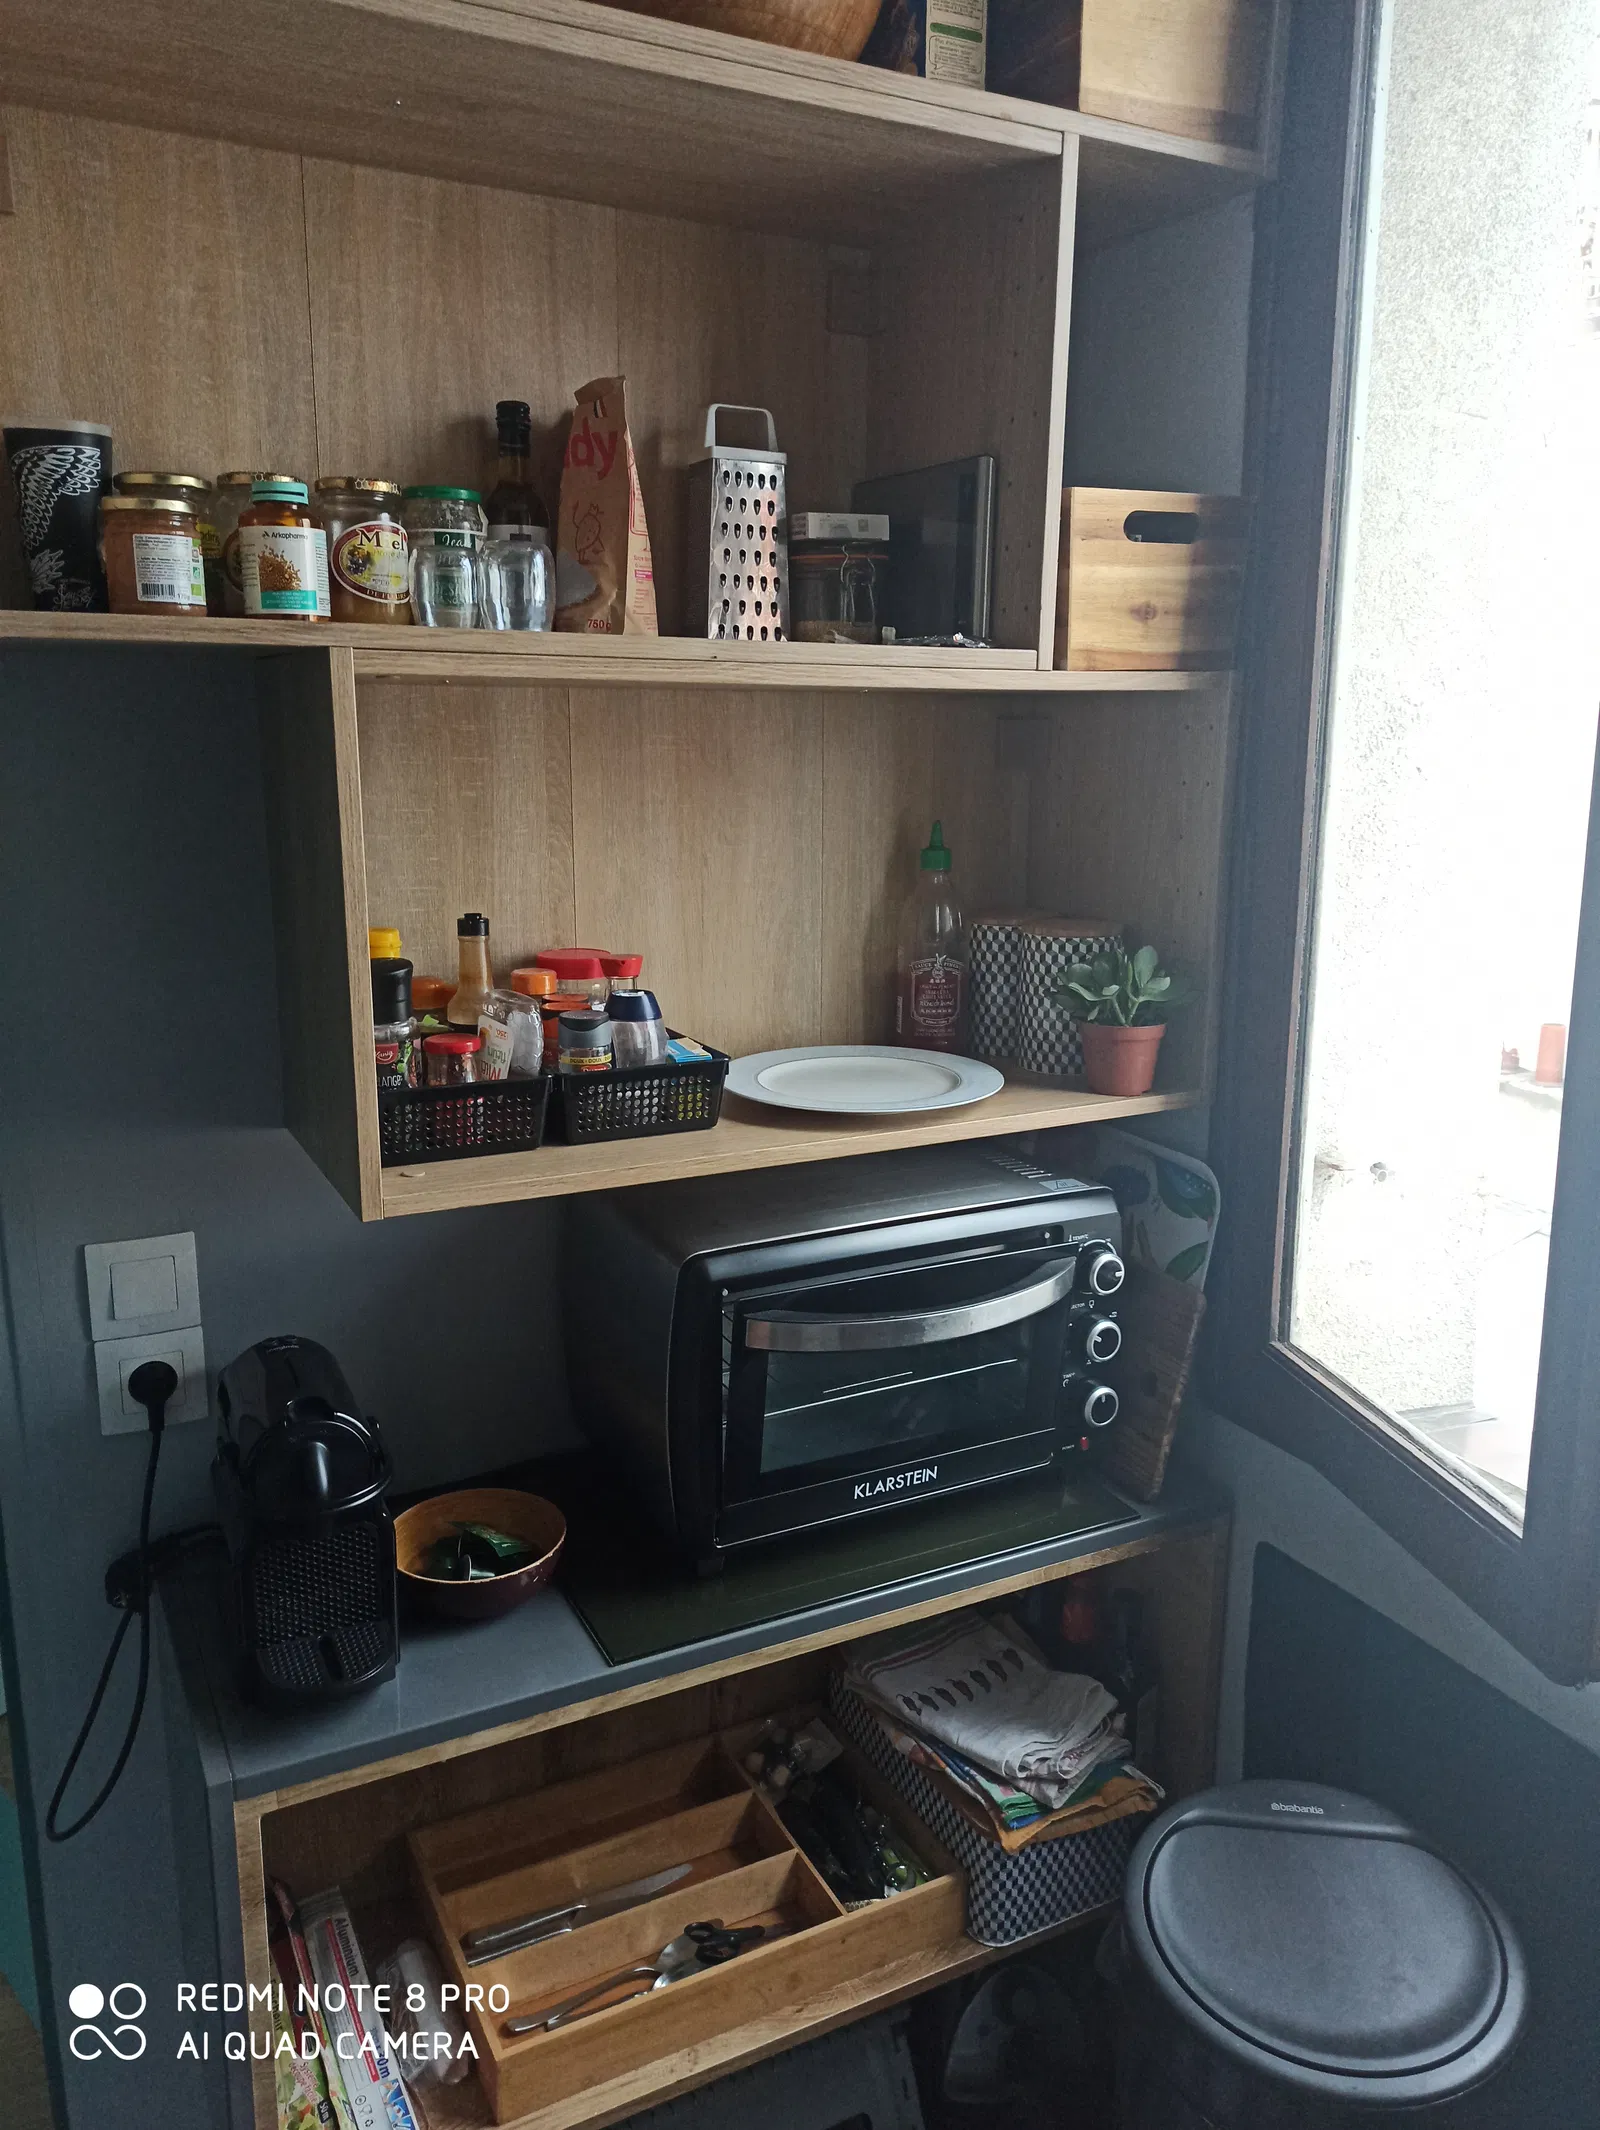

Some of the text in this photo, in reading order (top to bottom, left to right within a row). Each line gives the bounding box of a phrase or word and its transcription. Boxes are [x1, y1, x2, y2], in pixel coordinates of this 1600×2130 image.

[356, 529, 405, 551] Mel
[588, 619, 604, 629] 750
[853, 1465, 938, 1500] KLARSTEIN
[1279, 1802, 1324, 1815] brabantia
[335, 1918, 359, 1977] Aluminium
